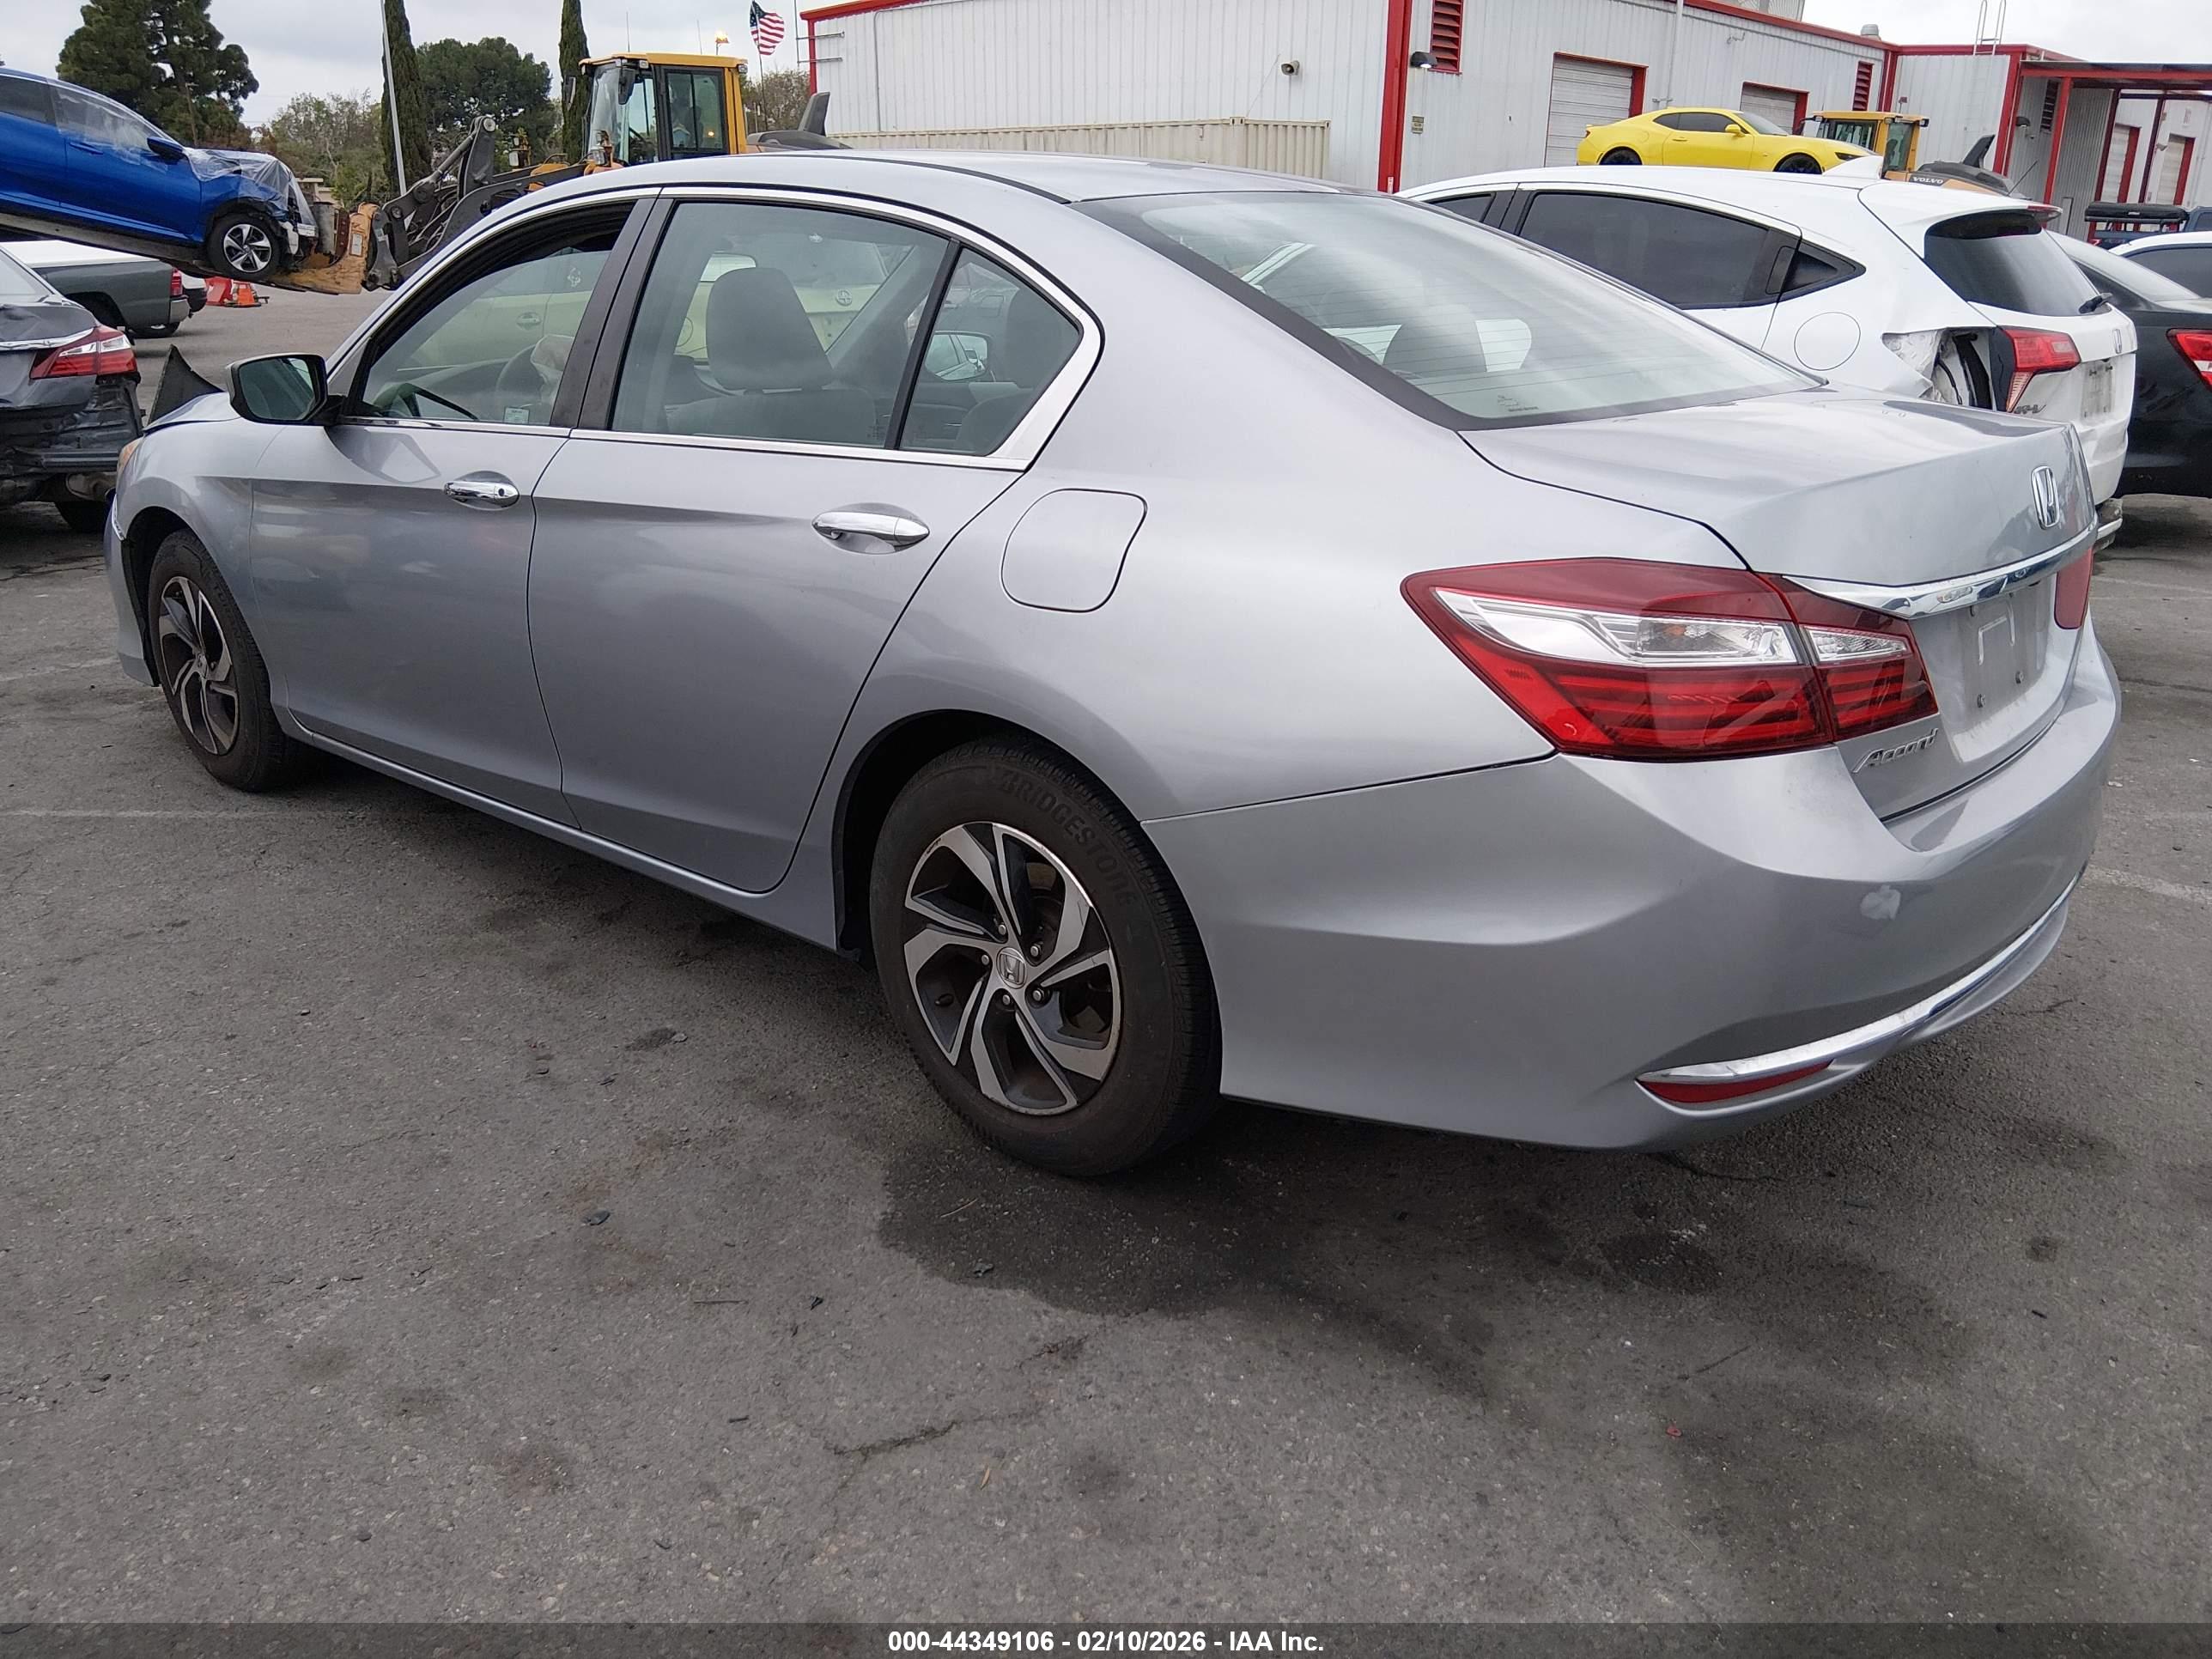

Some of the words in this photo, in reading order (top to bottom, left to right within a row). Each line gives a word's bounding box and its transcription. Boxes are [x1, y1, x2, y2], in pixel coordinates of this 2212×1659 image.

[1912, 176, 1944, 185] VOLVO
[1851, 727, 1939, 774] Accord
[1001, 770, 1138, 907] BRIDGESTONE
